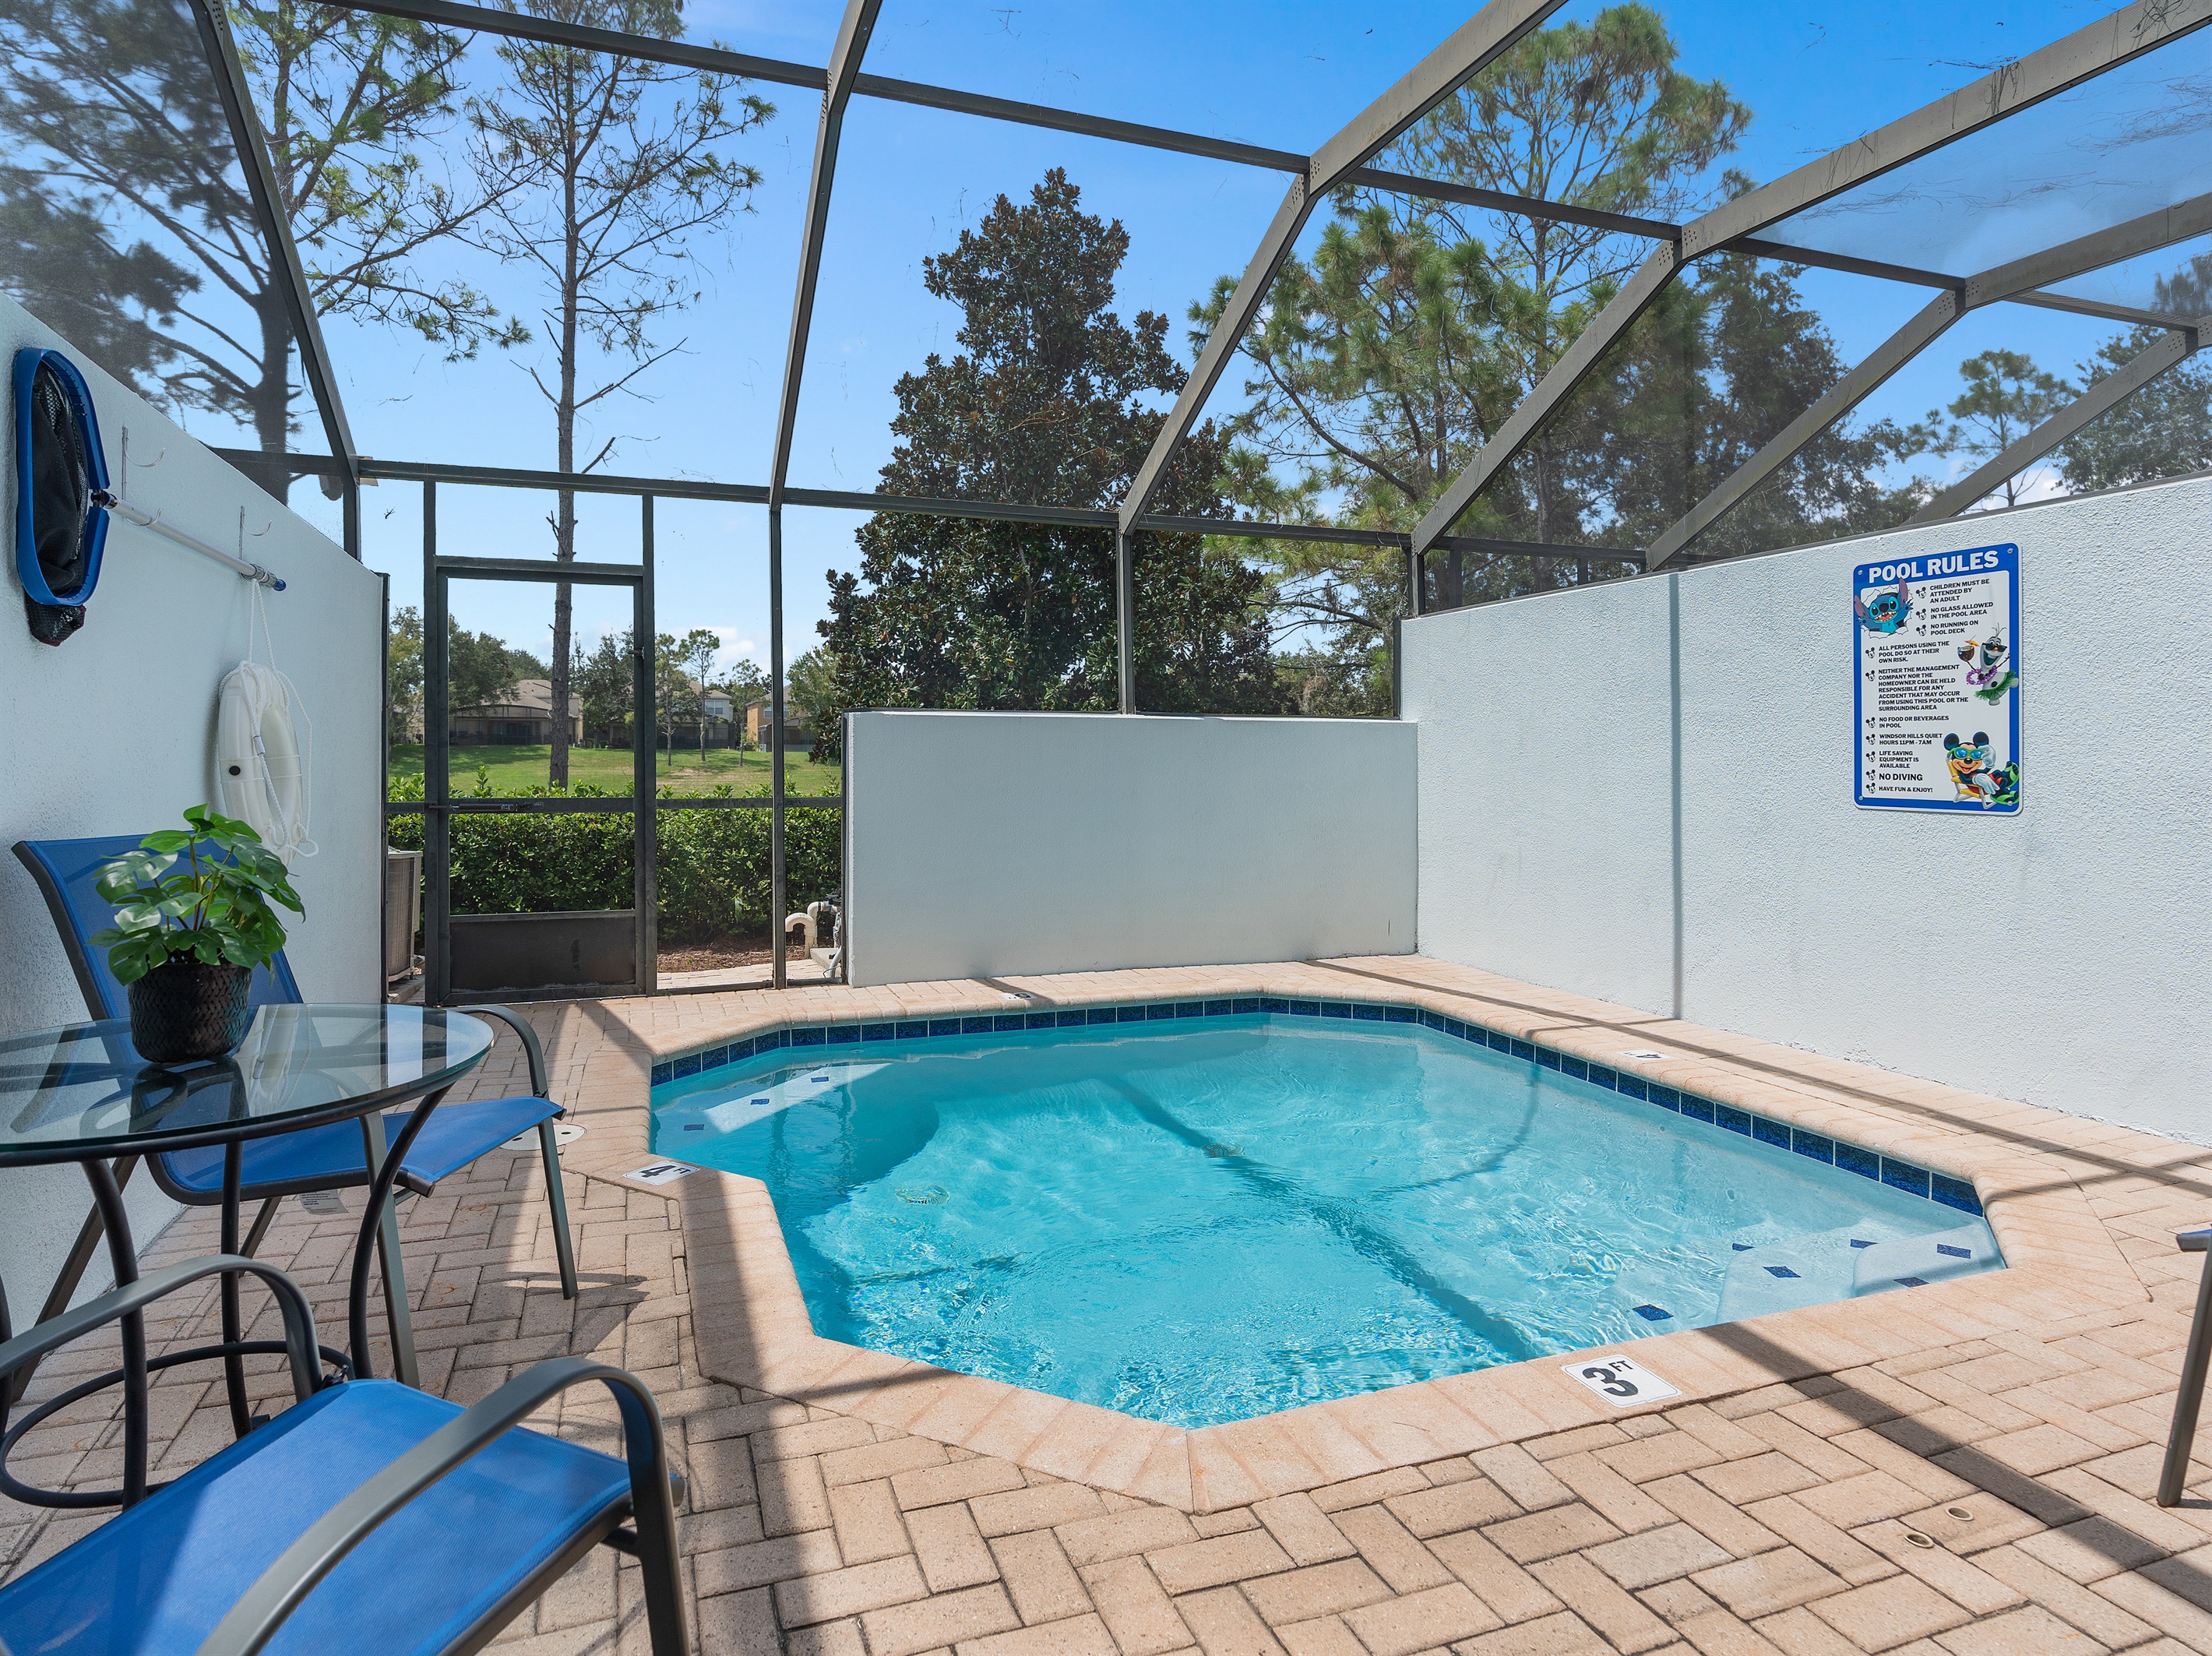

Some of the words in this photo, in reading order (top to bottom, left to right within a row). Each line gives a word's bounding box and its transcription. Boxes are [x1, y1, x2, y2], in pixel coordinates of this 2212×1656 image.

[1869, 562, 1923, 583] POOL
[1927, 550, 1999, 575] RULES
[639, 1165, 677, 1178] 4
[1608, 1361, 1633, 1372] FT
[1582, 1367, 1638, 1397] 3
